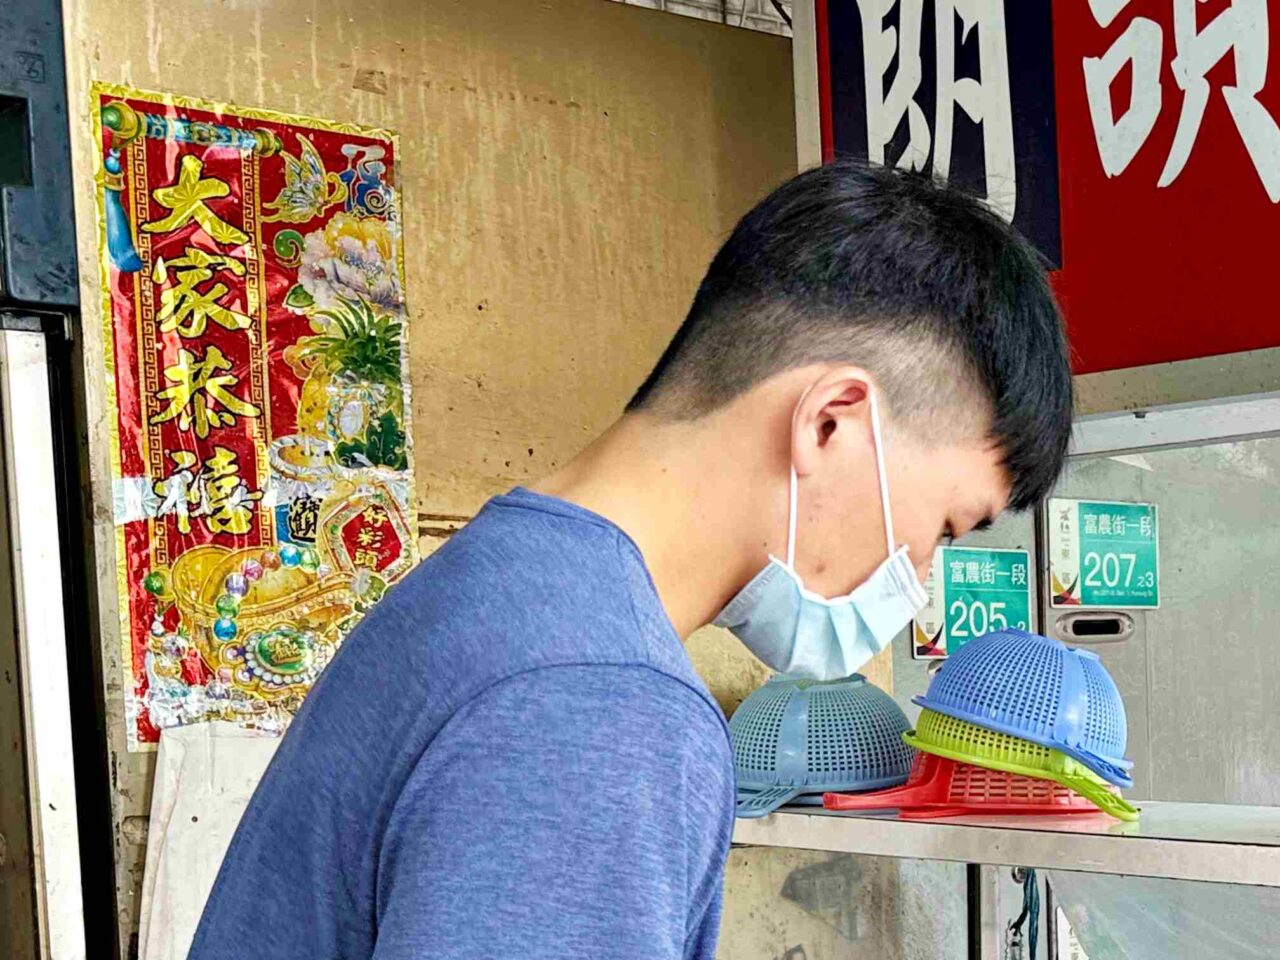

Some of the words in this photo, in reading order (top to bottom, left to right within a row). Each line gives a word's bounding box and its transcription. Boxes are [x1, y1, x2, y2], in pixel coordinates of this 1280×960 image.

[141, 154, 264, 535] 大家恭禧
[354, 505, 388, 571] 好彩頭
[1084, 514, 1154, 537] 富農街一段
[949, 560, 1026, 585] 富農街一段
